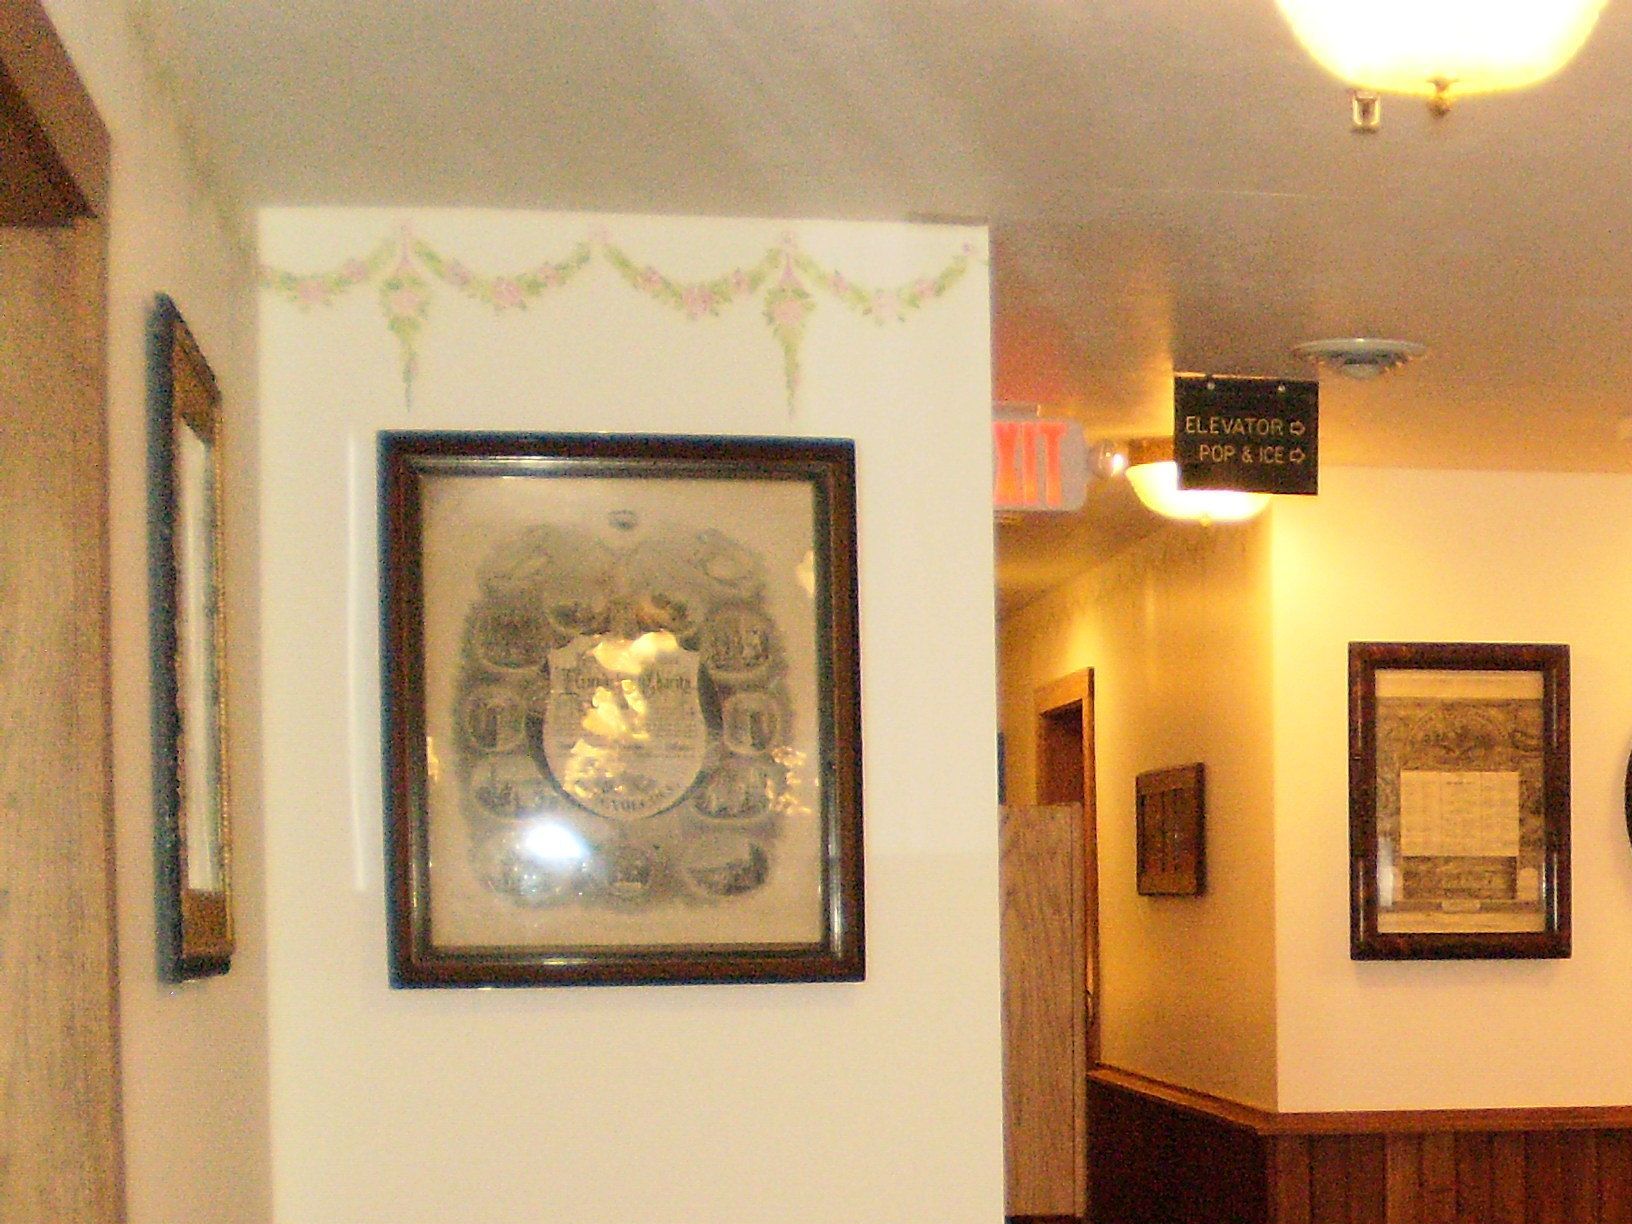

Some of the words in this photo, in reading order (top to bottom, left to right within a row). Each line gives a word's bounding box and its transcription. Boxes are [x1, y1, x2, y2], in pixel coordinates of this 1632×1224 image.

[1185, 415, 1284, 436] ELEVATOR
[992, 421, 1067, 506] XIT
[1200, 444, 1236, 462] POP
[1241, 447, 1254, 463] &
[1259, 446, 1285, 464] ICE
